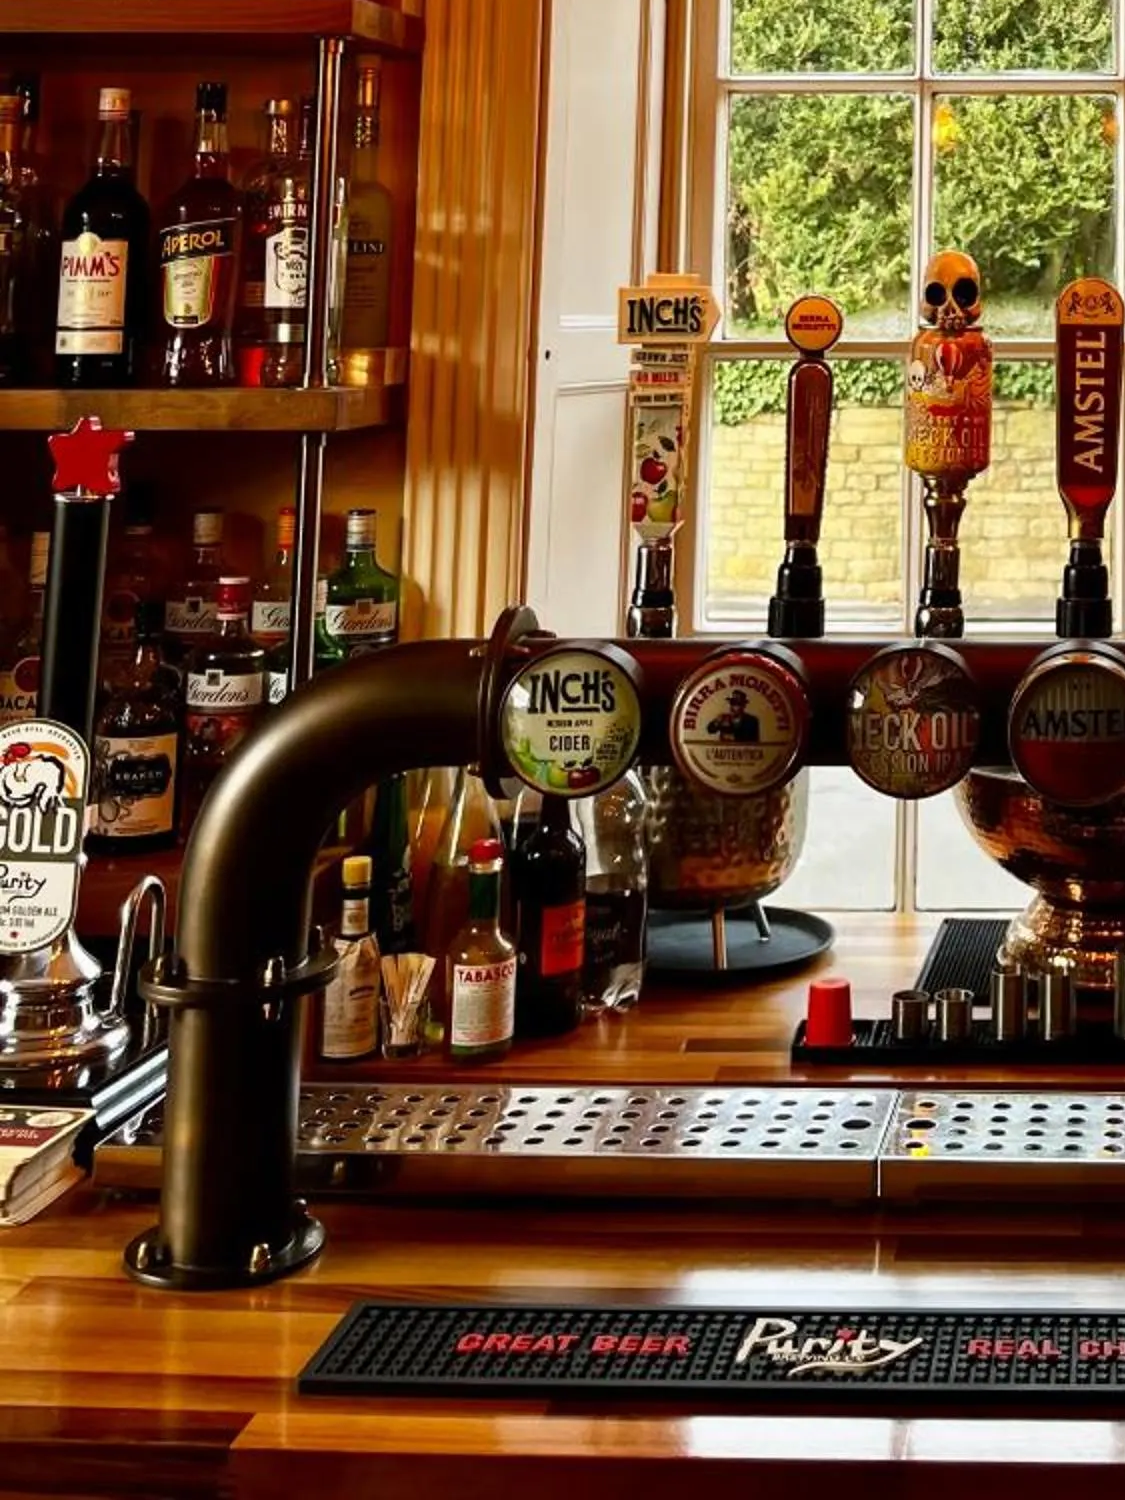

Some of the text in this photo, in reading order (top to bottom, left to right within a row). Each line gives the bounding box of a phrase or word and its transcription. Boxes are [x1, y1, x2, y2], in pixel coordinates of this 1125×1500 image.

[267, 203, 308, 219] SMIRN
[161, 230, 225, 258] APEROL
[353, 242, 384, 253] LINI
[62, 252, 120, 277] PIMM'S
[627, 296, 703, 333] INCH'S
[651, 372, 679, 384] MILES
[1073, 331, 1106, 473] AMSTEL
[961, 428, 985, 448] OIL
[188, 678, 250, 701] Gordon's
[528, 669, 616, 714] INCH'S
[684, 674, 789, 731] BIRRA MORETTI
[852, 710, 977, 751] NECK OIL
[549, 735, 591, 751] CIDER
[115, 771, 164, 781] KRAKEN
[44, 907, 58, 917] ALE
[457, 963, 514, 982] TABASCO
[456, 1332, 693, 1357] GREAT BEER
[735, 1317, 923, 1376] Purity
[966, 1339, 1061, 1357] REAL
